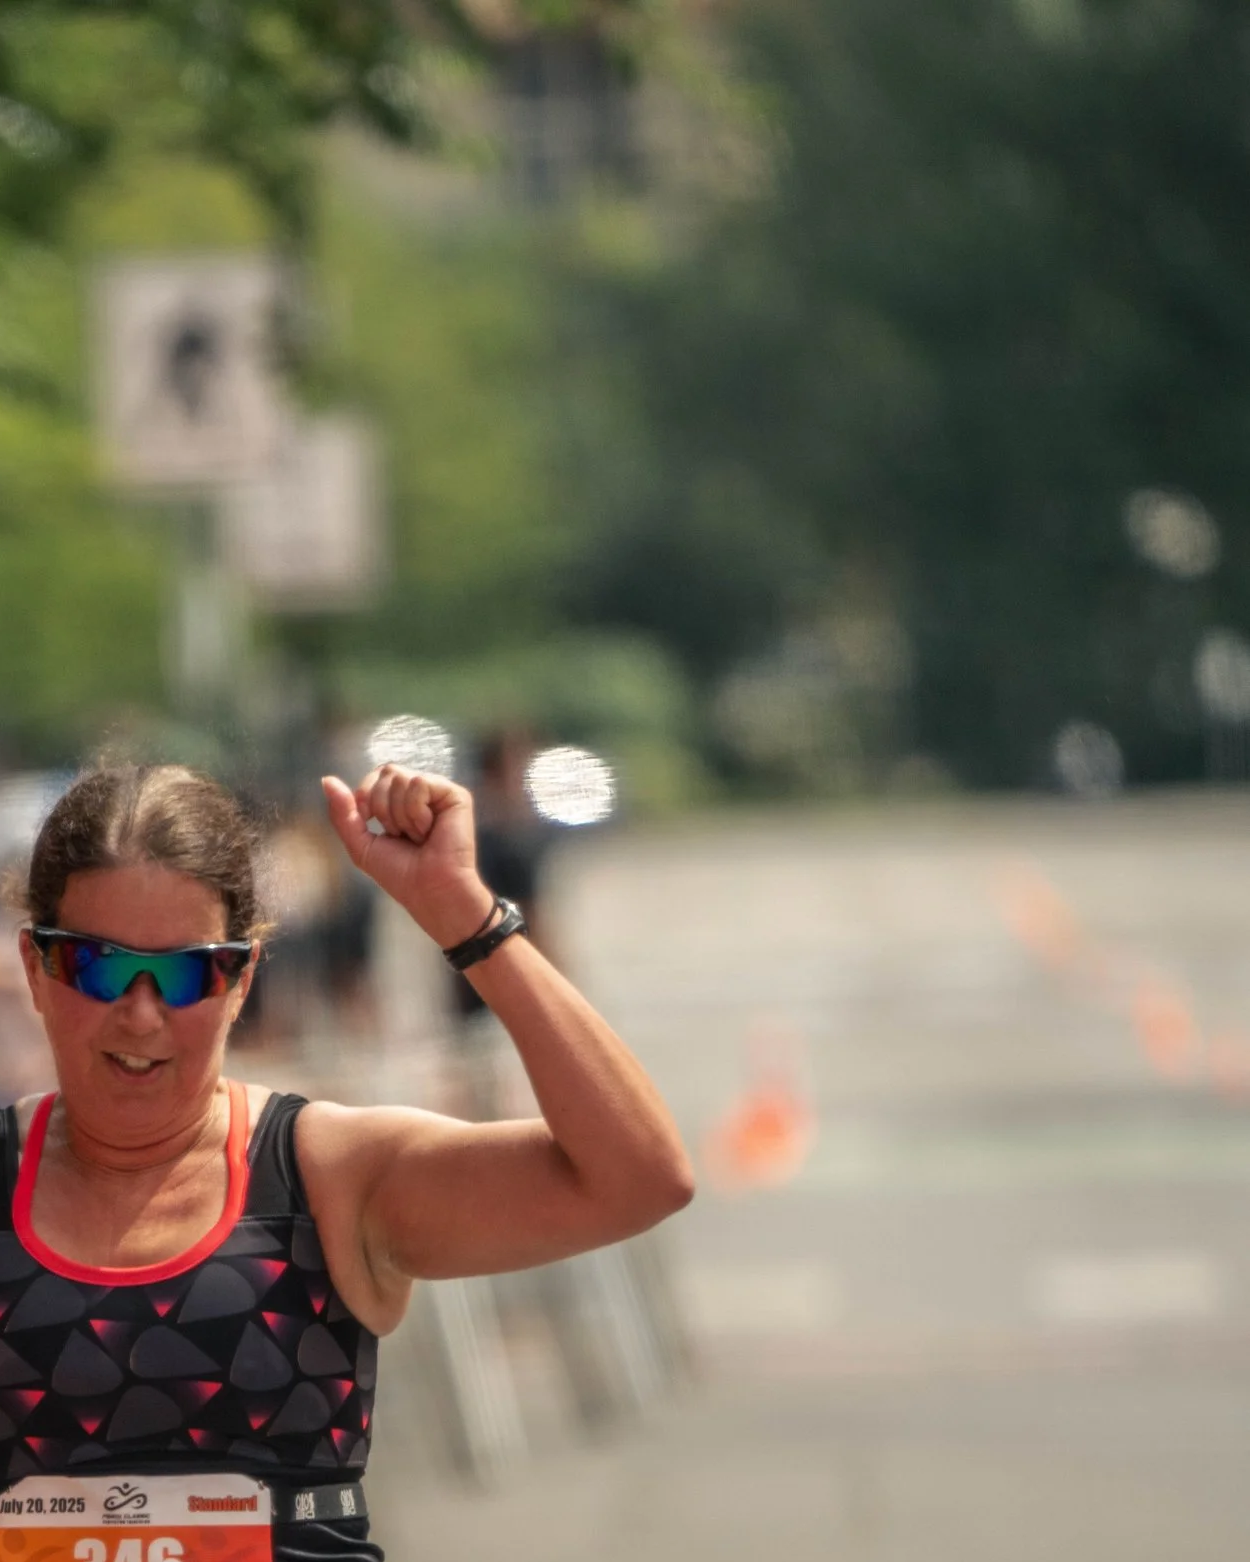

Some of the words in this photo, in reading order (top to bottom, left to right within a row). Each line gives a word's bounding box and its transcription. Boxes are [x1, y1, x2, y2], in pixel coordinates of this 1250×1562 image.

[0, 1499, 23, 1514] July
[26, 1498, 47, 1514] 20,
[50, 1498, 86, 1513] 2025
[188, 1495, 258, 1512] Standard
